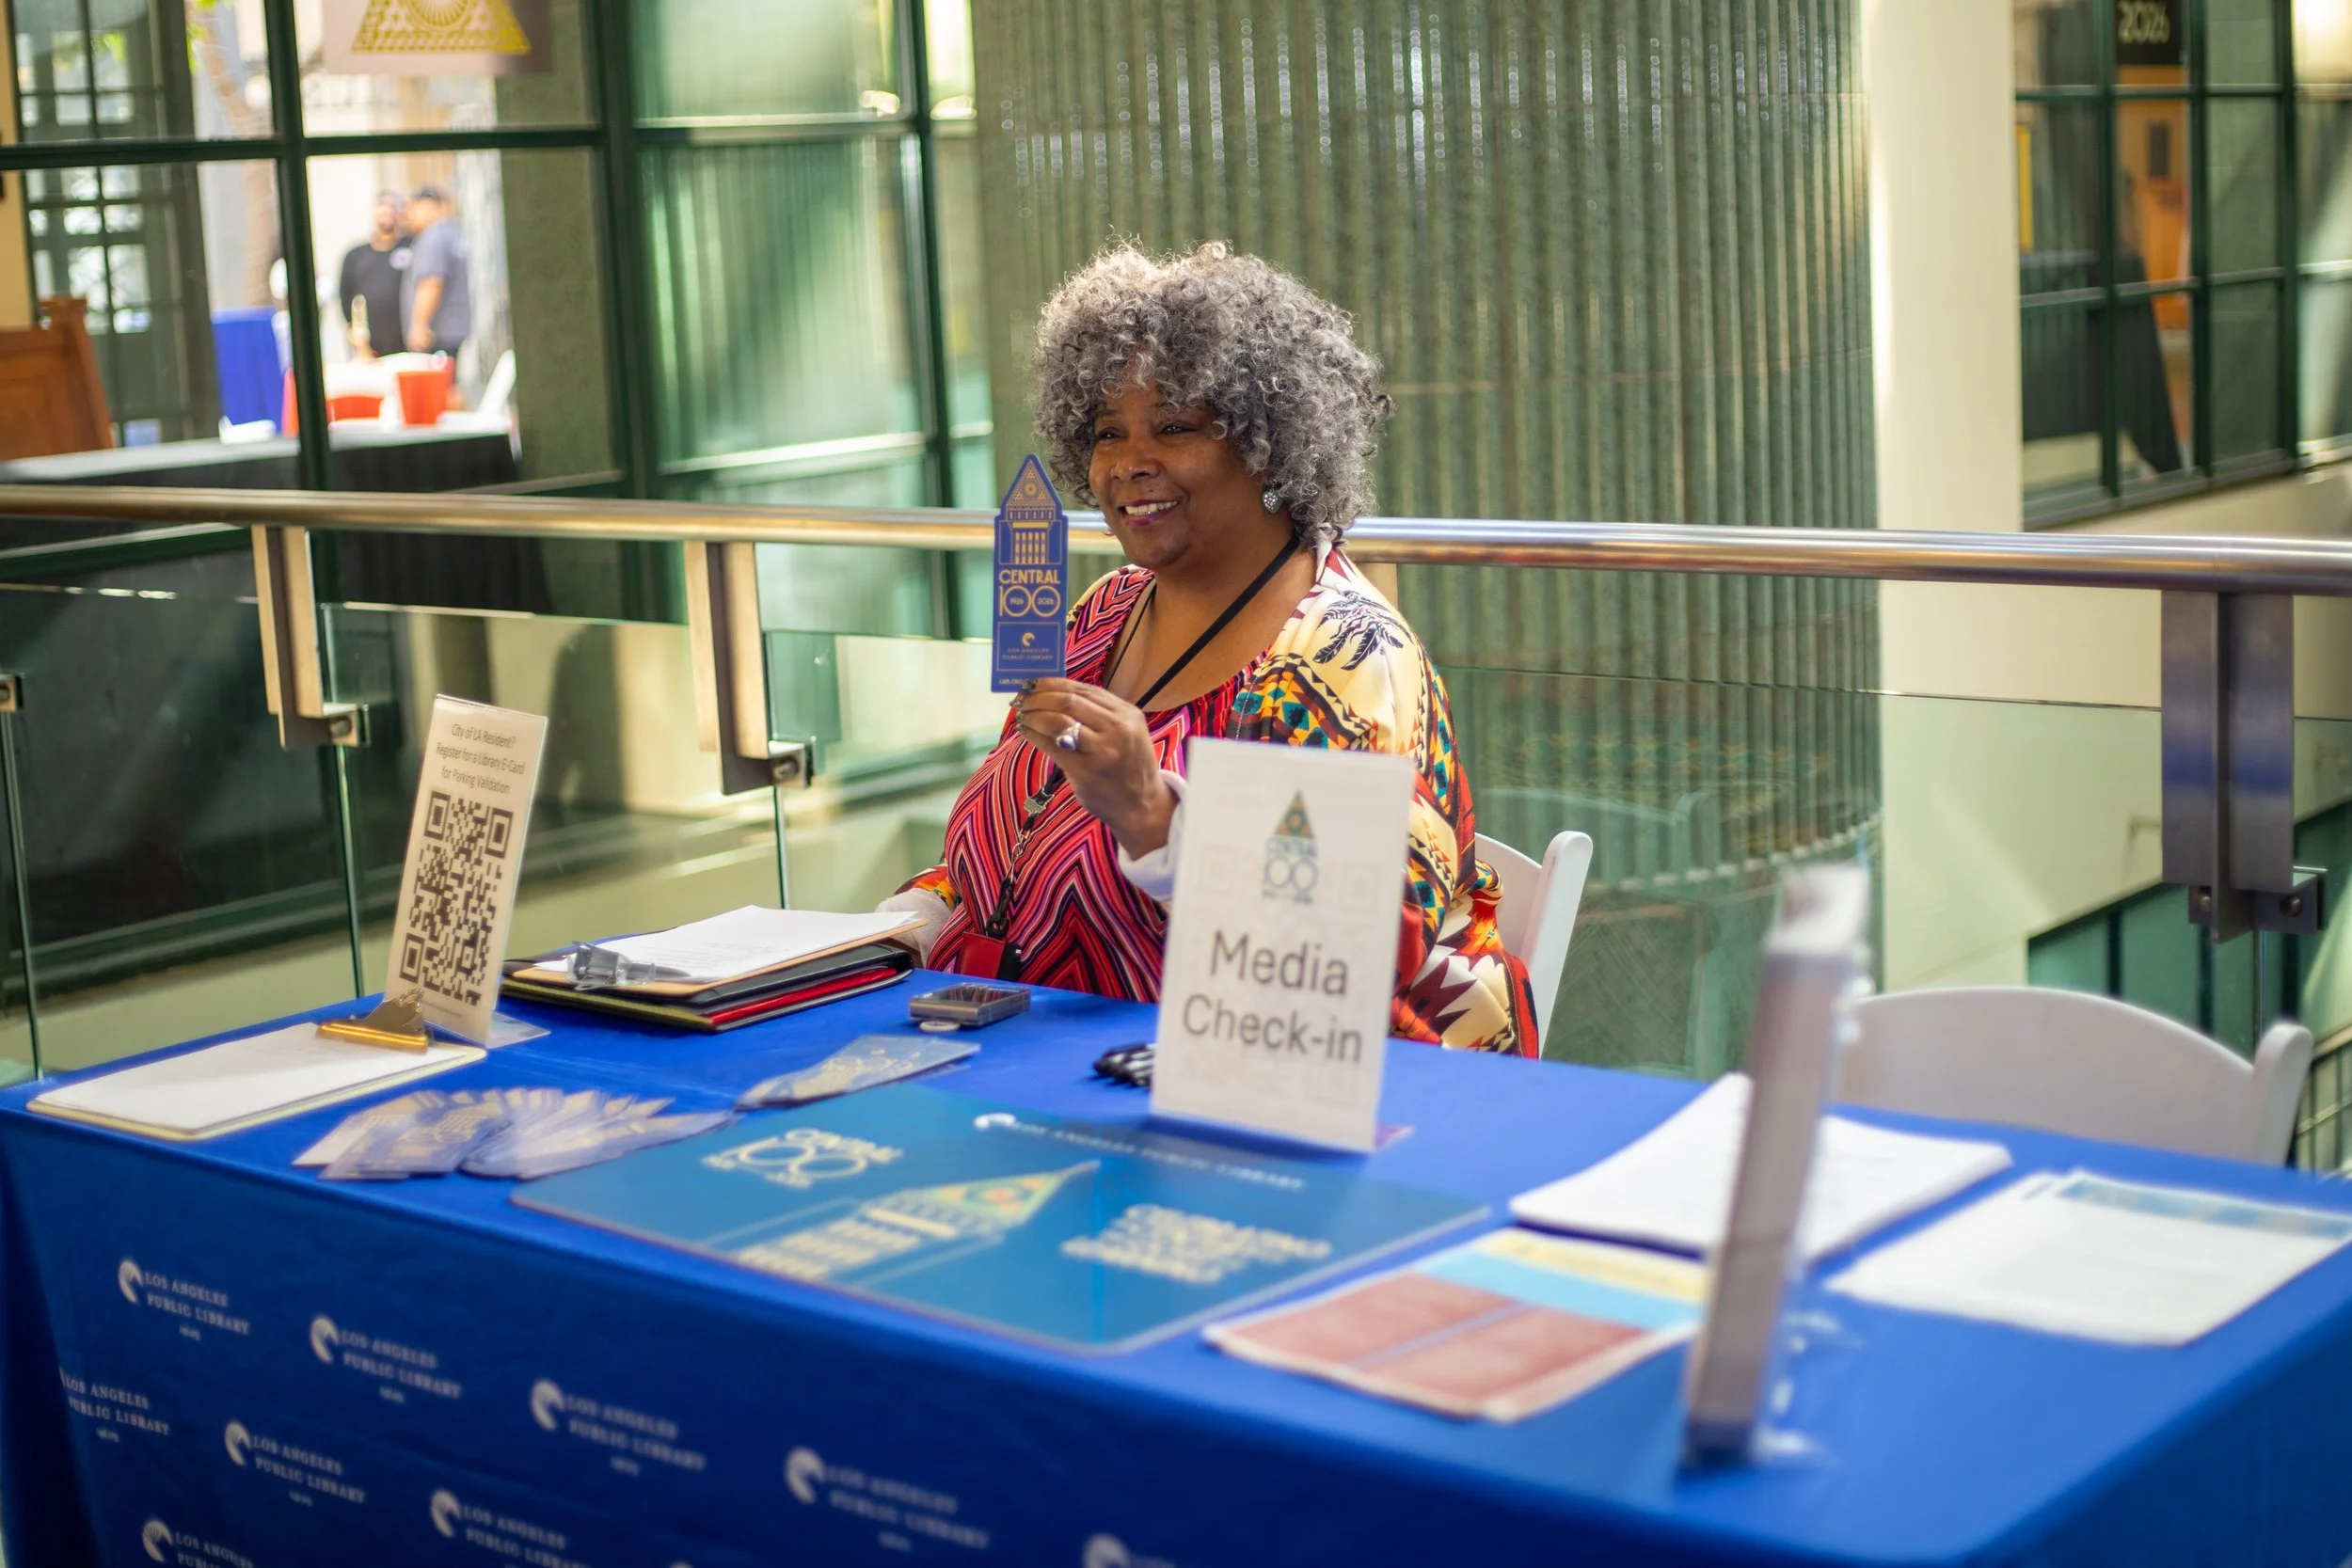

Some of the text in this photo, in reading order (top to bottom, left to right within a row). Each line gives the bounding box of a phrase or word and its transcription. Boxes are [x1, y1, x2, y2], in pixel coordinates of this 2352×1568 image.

[999, 569, 1061, 584] CENTRAL
[999, 585, 1061, 617] 100
[452, 723, 516, 749] City of LA Resident?
[437, 742, 462, 759] Register
[462, 748, 472, 761] for
[478, 752, 501, 770] Library
[501, 758, 525, 774] E-Card
[442, 766, 510, 795] for Parking Validation
[1210, 929, 1349, 995] Media
[1183, 993, 1363, 1063] Check-in
[145, 1272, 228, 1307] LOS ANGELES
[147, 1293, 191, 1317] PUBLIC
[195, 1307, 249, 1335] LIBRARY
[341, 1330, 437, 1369] LOS ANGELES
[66, 1376, 149, 1409] LOS ANGELES
[343, 1353, 393, 1378] PUBLIC
[399, 1370, 461, 1399] LIBRARY
[68, 1396, 110, 1419] PUBLIC
[116, 1410, 169, 1435] LIBRARY
[253, 1436, 342, 1475] LOS ANGELES
[255, 1457, 302, 1483] PUBLIC
[308, 1474, 365, 1503] LIBRARY
[175, 1532, 199, 1549] LOS
[463, 1505, 566, 1550] LOS ANGELES
[466, 1528, 520, 1557] PUBLIC
